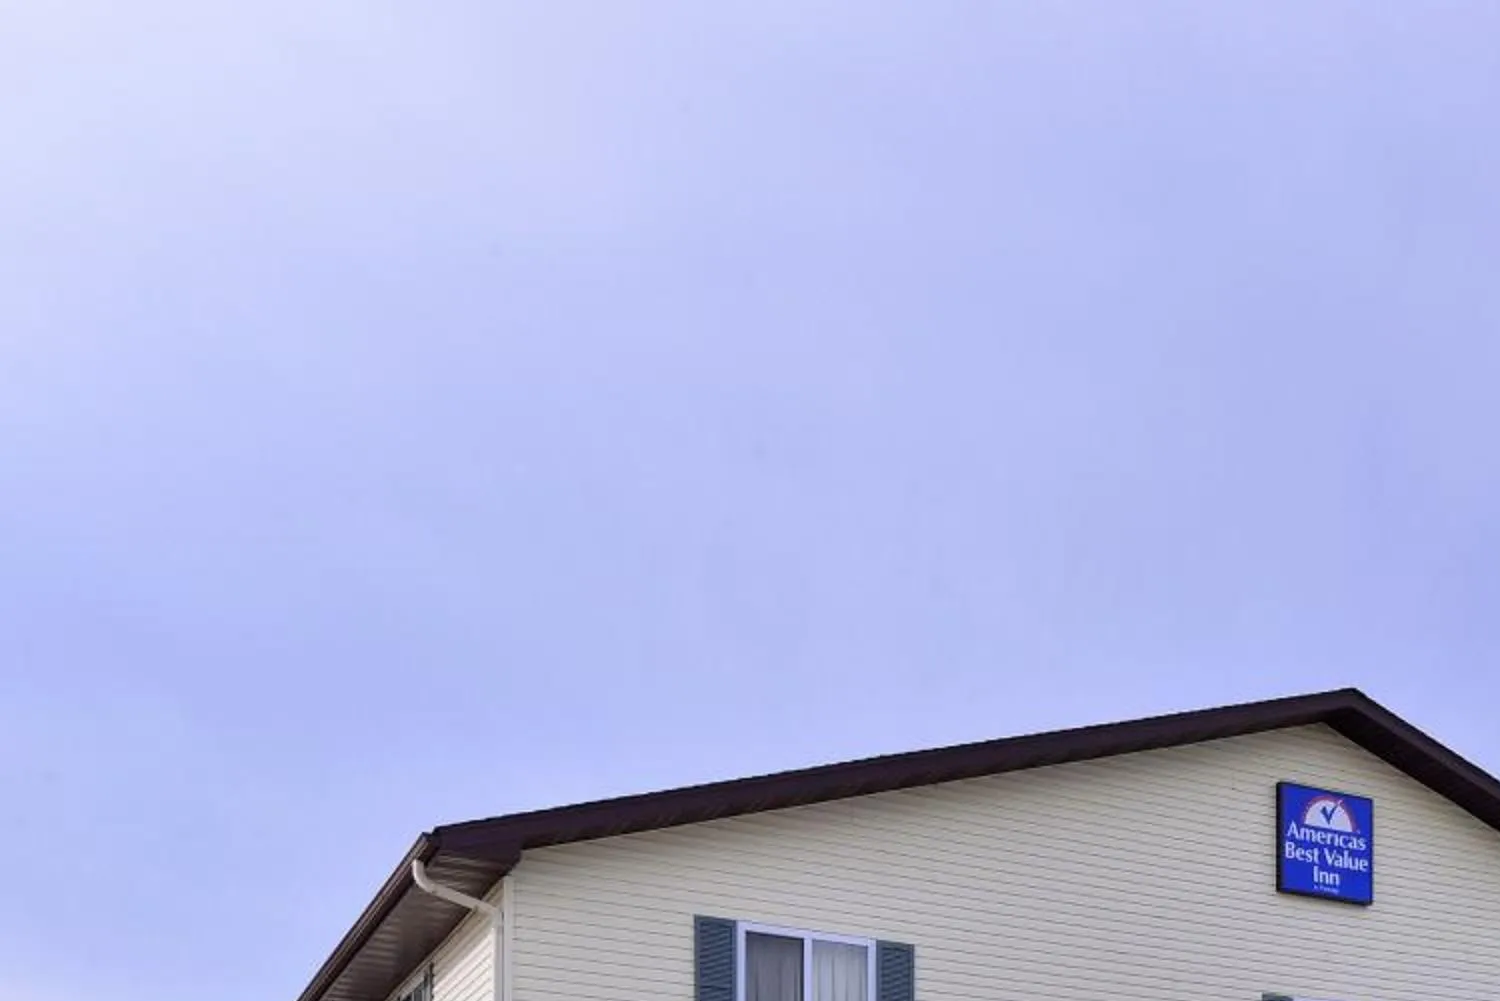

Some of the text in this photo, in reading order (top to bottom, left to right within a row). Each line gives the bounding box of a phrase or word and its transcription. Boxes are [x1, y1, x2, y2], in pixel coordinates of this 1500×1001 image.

[1287, 821, 1366, 851] Americas
[1285, 841, 1368, 871] Best Value
[1313, 865, 1340, 885] Inn
